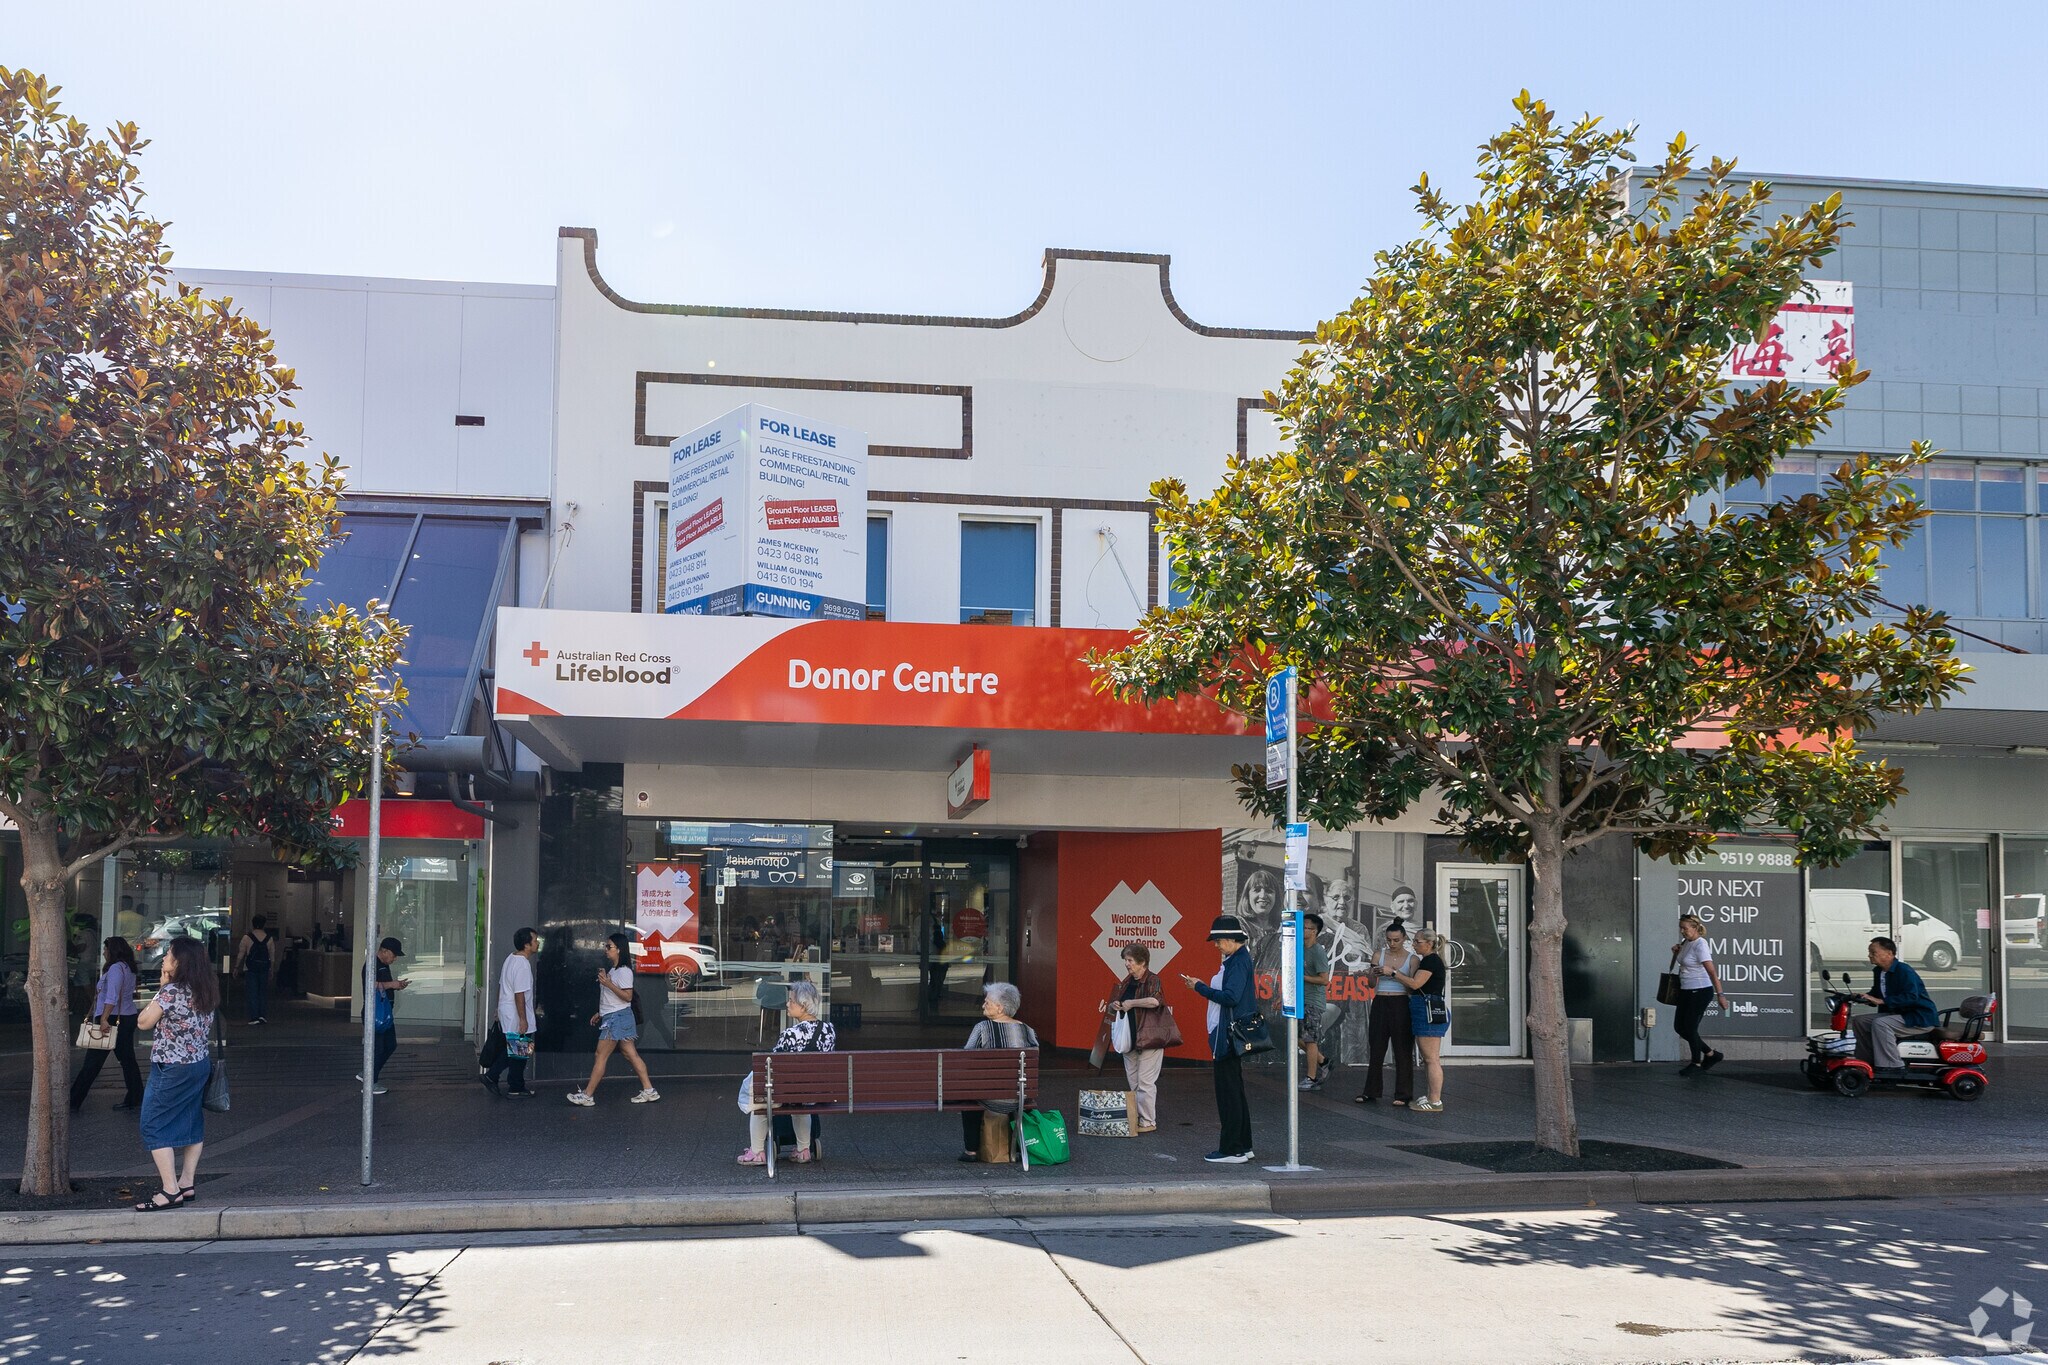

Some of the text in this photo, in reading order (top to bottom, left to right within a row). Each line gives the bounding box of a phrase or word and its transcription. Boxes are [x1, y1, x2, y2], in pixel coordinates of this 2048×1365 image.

[760, 418, 836, 448] FOR LEASE
[673, 431, 722, 464] FOR LEASE
[672, 450, 735, 486] LARGE FREESTANDING
[760, 444, 856, 475] LARGE FREESTANDING
[760, 458, 850, 486] COMMERCIAL/RETAIL
[760, 471, 805, 489] BUILDING!
[672, 466, 730, 498] COMMERCIAL/RETAIL
[671, 491, 699, 511] BUILDING!
[767, 505, 836, 515] Ground Floor LEASED
[676, 521, 692, 538] Ground
[691, 517, 704, 529] Floor
[703, 503, 722, 520] LEASED
[697, 512, 723, 534] AVAILABLE
[768, 515, 838, 526] First Floor AVAILABLE
[810, 527, 821, 535] car
[757, 537, 820, 555] JAMES MCKENNY
[669, 549, 707, 569] JAMES MCKENNY
[757, 546, 819, 566] 0423 048 814
[668, 558, 707, 580] 0423 048 814
[757, 561, 823, 580] WILLIAM GUNNING
[668, 571, 710, 591] WILLIAM GUNNING
[757, 570, 814, 589] 0413 610 194
[681, 586, 692, 598] 610
[692, 583, 704, 594] 194
[756, 592, 812, 611] GUNNING
[823, 603, 860, 617] 9698 0222
[556, 650, 672, 663] Australian Red Cross
[788, 659, 999, 695] Donor Centre
[1719, 852, 1754, 865] 9519
[1757, 853, 1792, 867] 9888
[641, 889, 672, 898] 请成为本
[1718, 879, 1765, 898] NEXT
[641, 908, 679, 918] 人的献血者
[1111, 914, 1162, 925] Welcome to
[1719, 906, 1759, 924] SHIP
[1115, 926, 1158, 937] Hurstville
[1732, 938, 1783, 956] MULTI
[1732, 1001, 1759, 1013] belle
